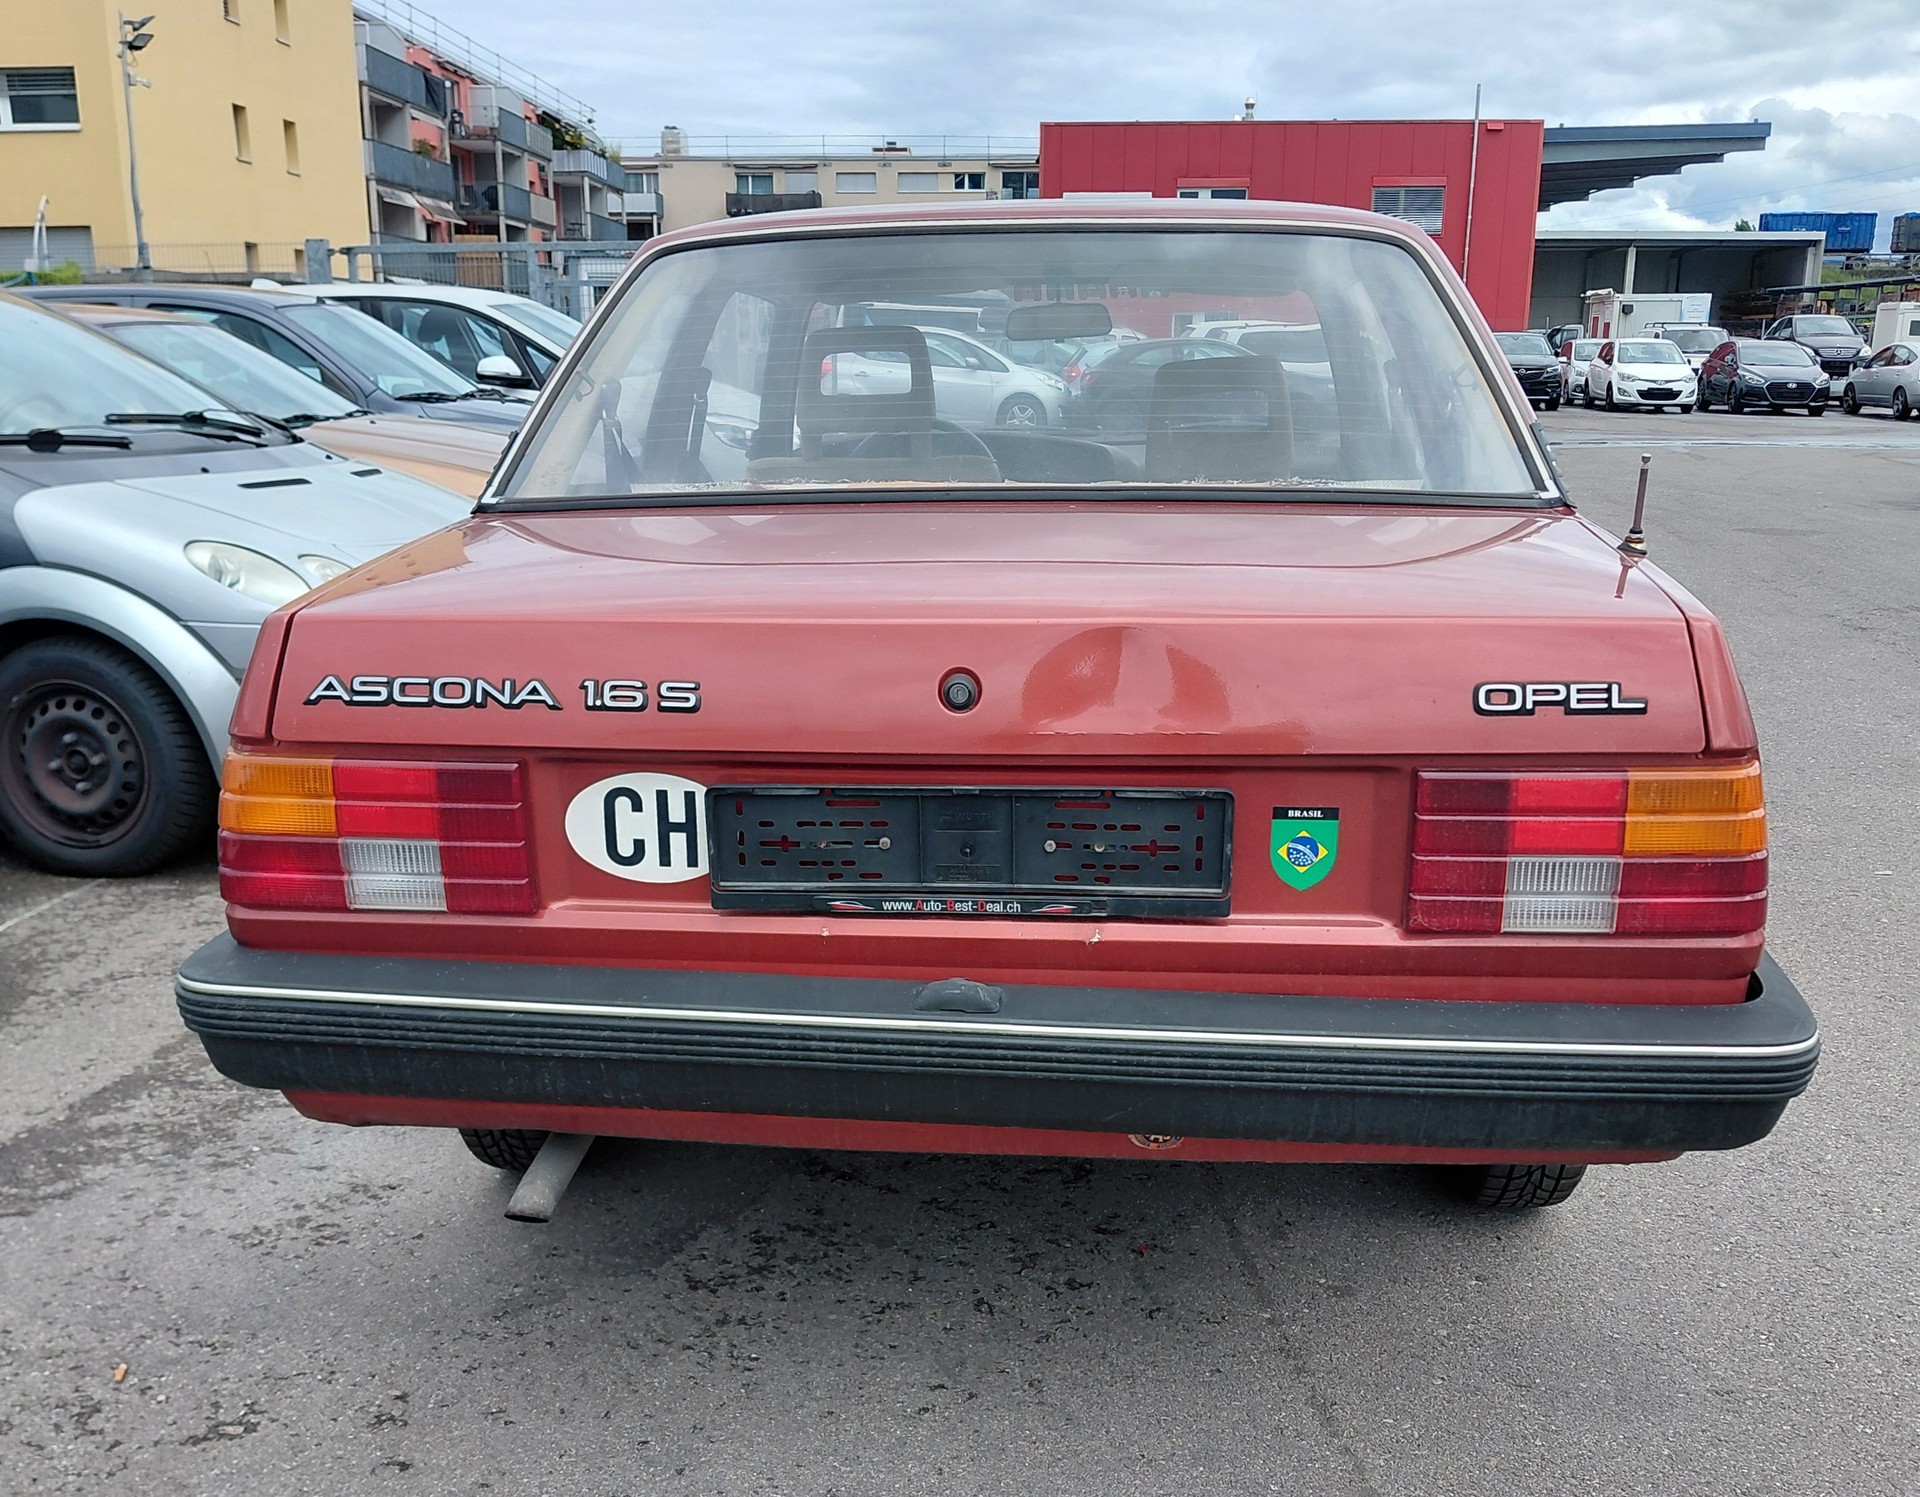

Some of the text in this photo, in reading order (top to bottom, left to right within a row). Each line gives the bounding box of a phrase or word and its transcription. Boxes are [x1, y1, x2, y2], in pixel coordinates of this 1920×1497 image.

[304, 675, 701, 712] ASCONA 1.6 S
[1474, 682, 1647, 715] OPEL
[603, 786, 699, 868] CH
[1287, 809, 1324, 818] BRASIL
[881, 900, 1021, 913] www.Auto-Best-Deal.ch
